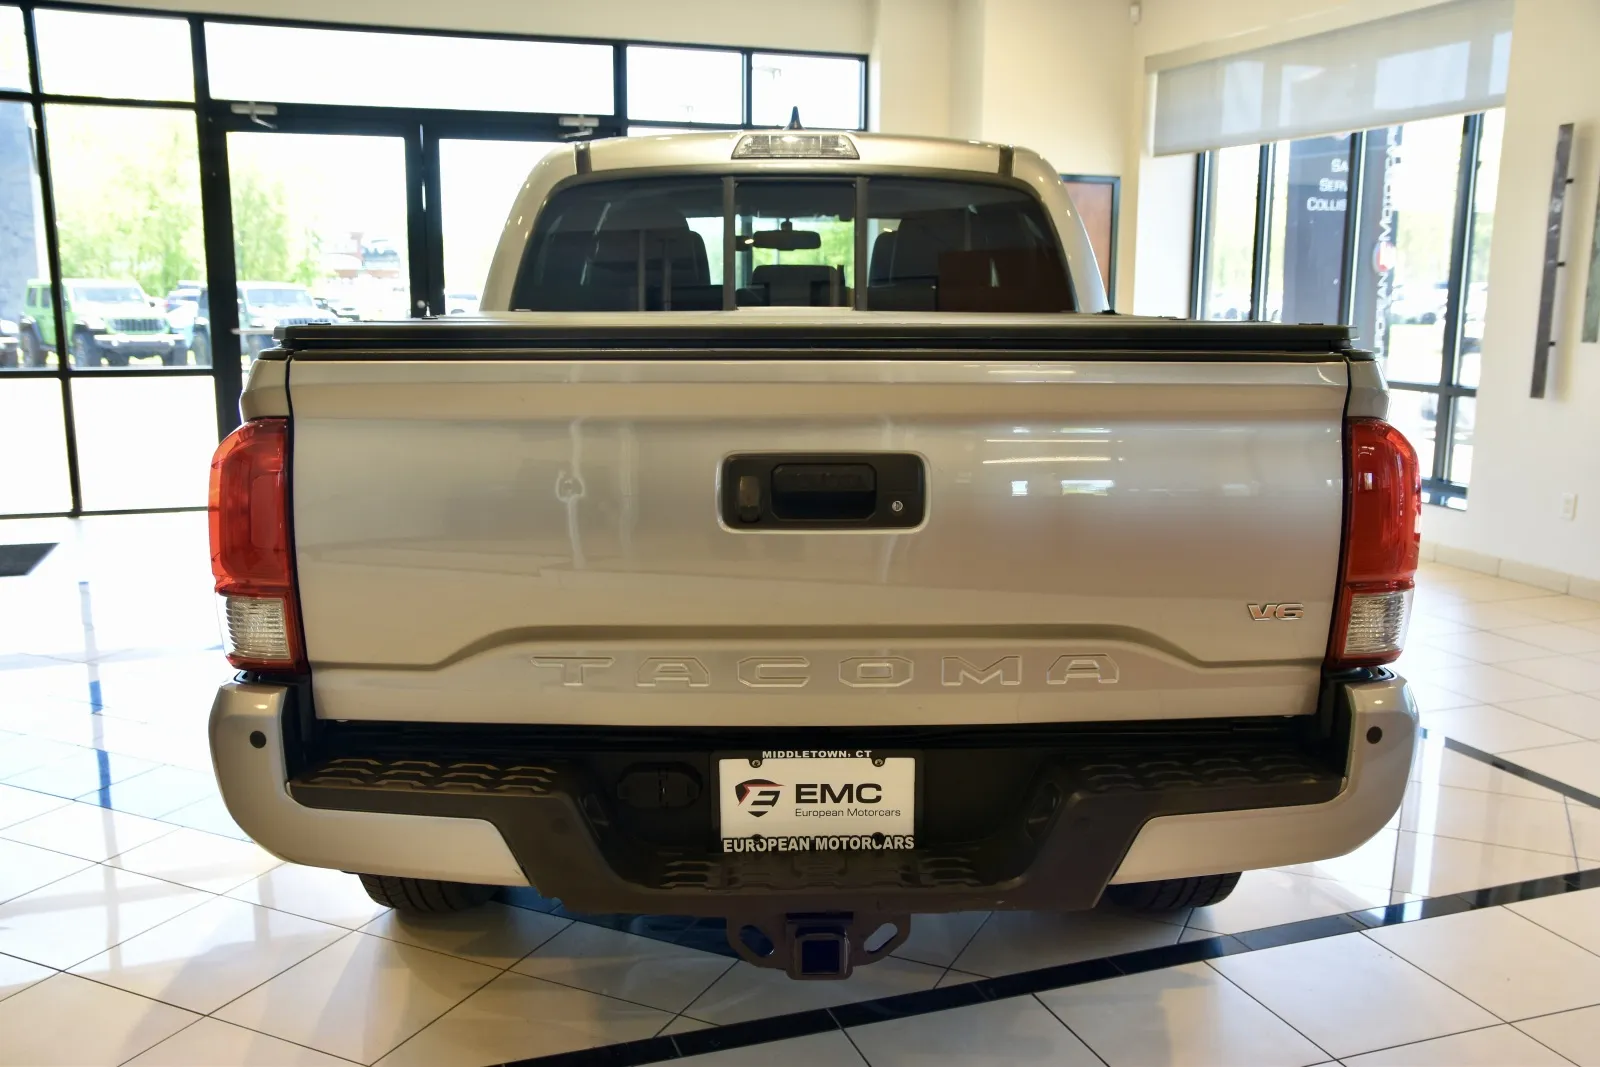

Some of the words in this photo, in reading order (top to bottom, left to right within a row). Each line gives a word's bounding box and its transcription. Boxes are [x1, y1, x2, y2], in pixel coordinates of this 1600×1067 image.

[1247, 603, 1304, 621] V6
[531, 654, 1120, 688] TACOMA
[855, 750, 872, 758] CT
[795, 783, 883, 804] EMC
[795, 808, 844, 818] European
[847, 808, 901, 817] Motorcars
[723, 838, 810, 853] EUROPEAN
